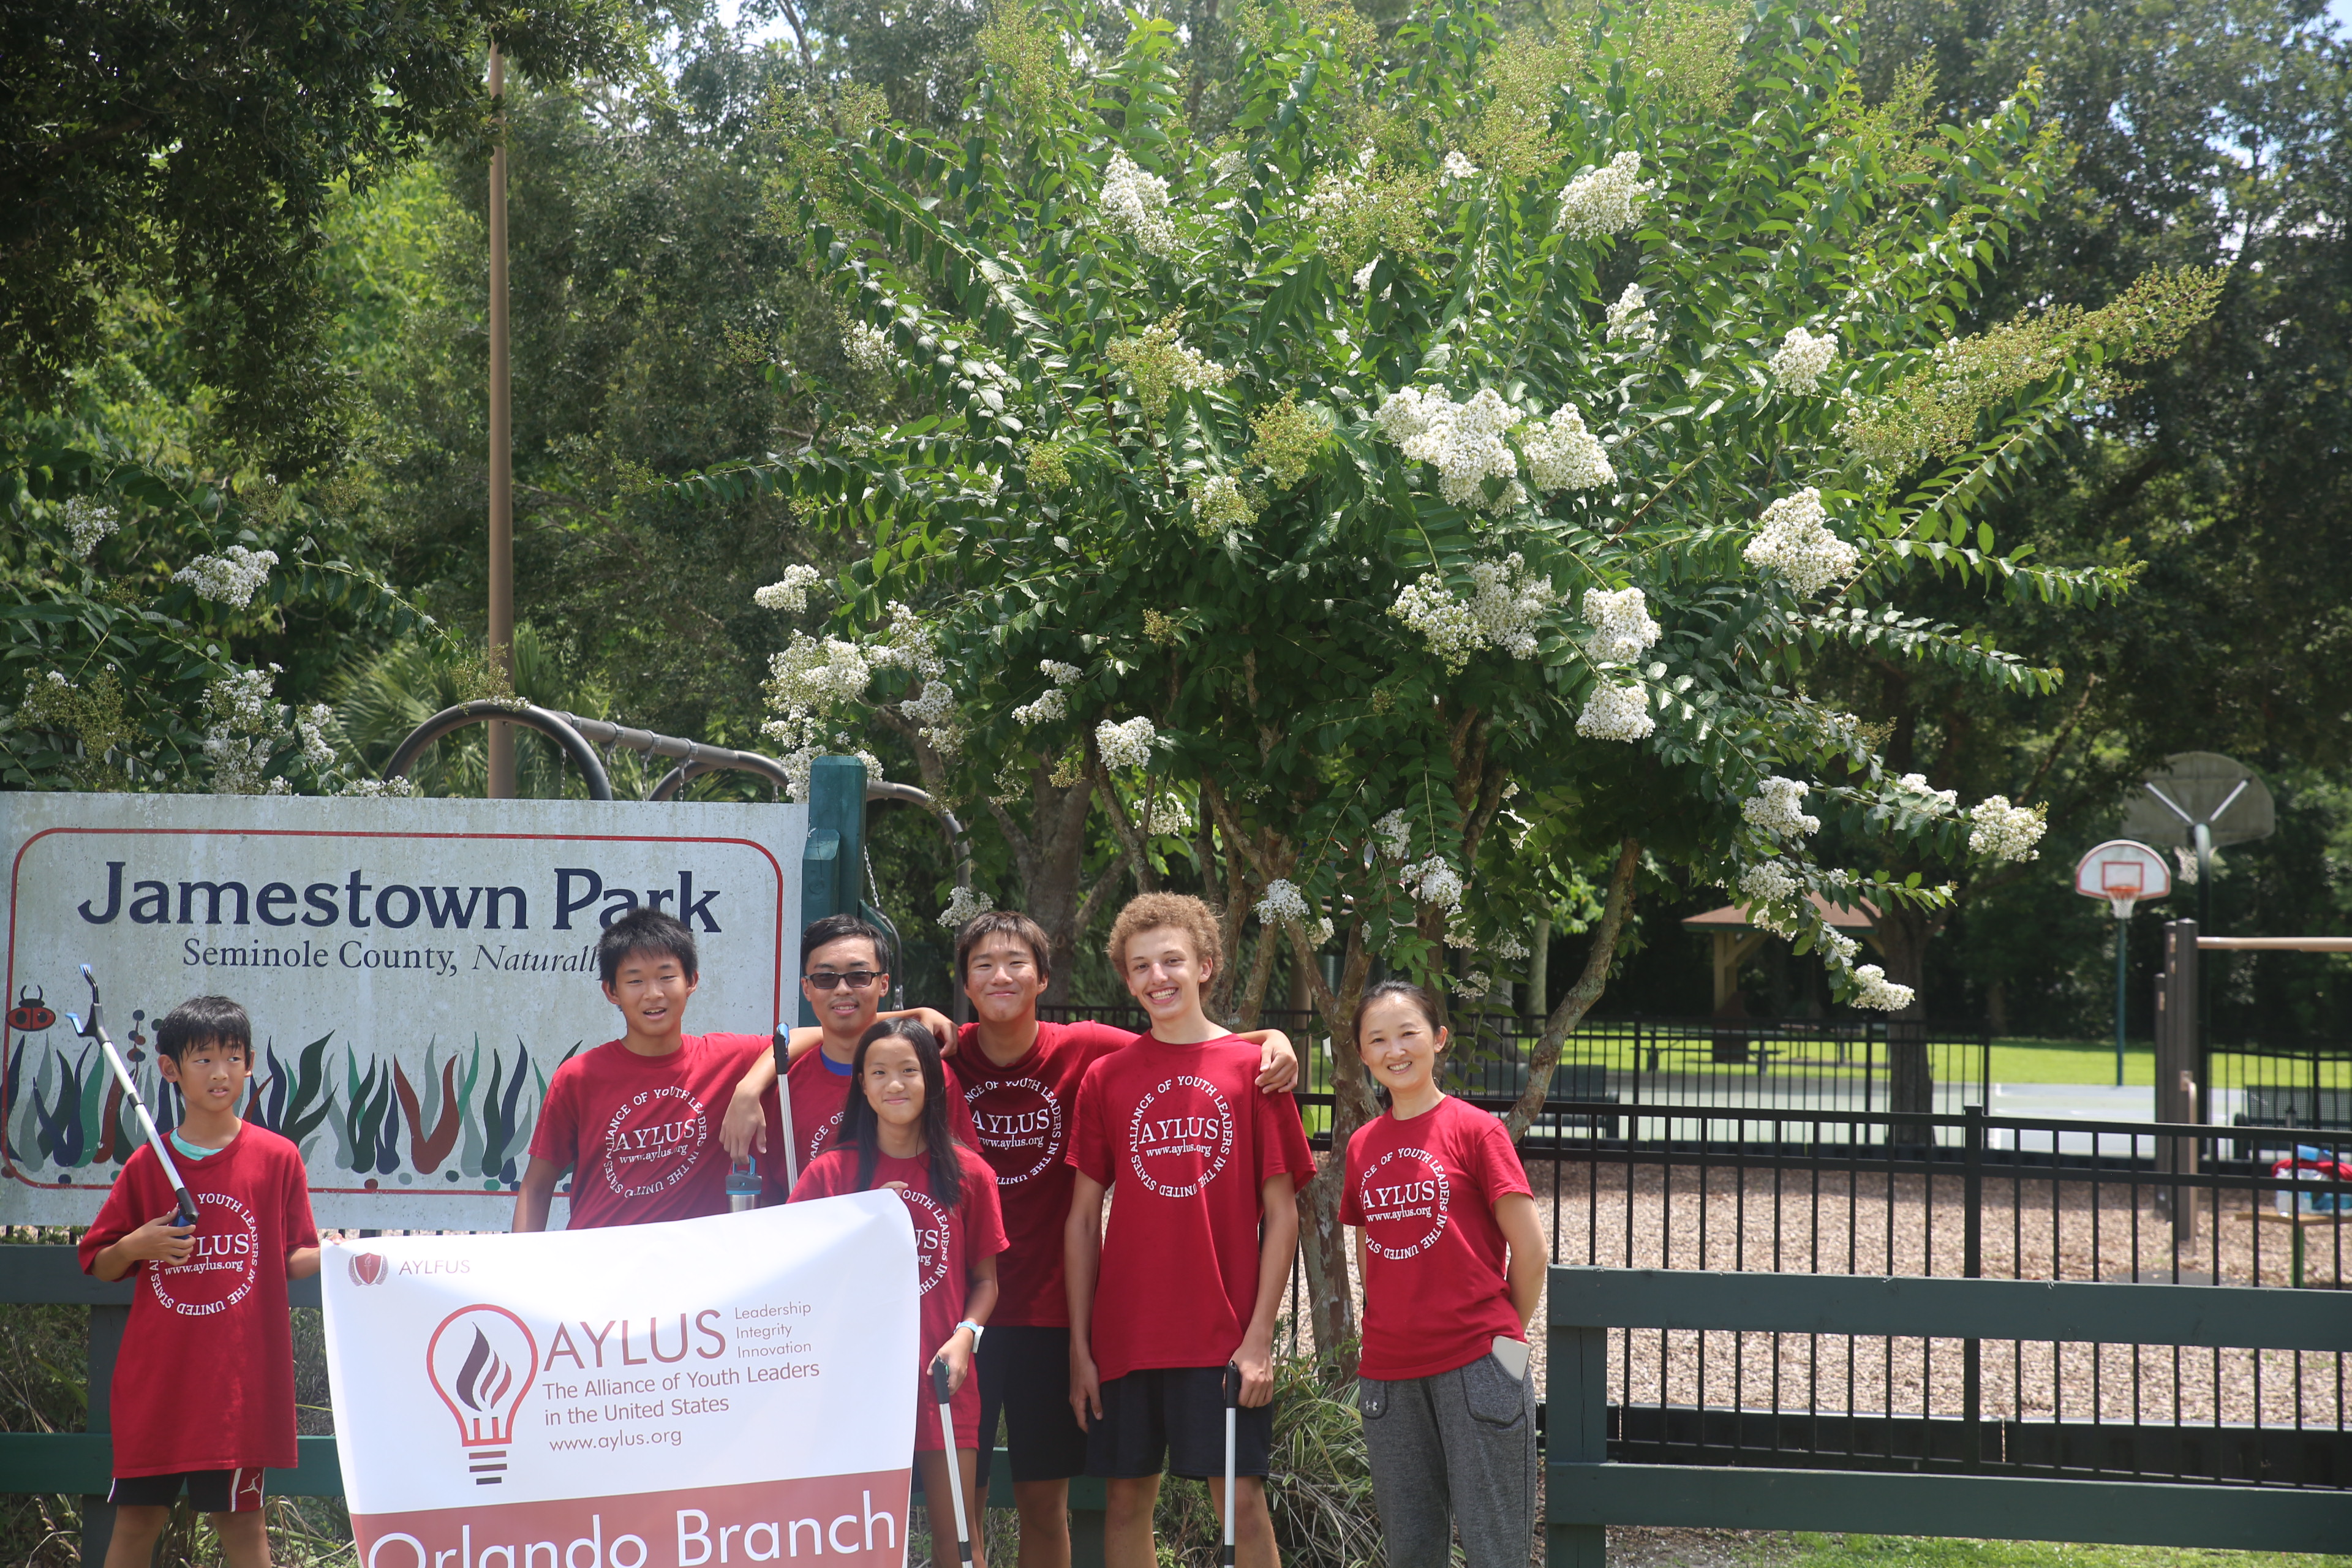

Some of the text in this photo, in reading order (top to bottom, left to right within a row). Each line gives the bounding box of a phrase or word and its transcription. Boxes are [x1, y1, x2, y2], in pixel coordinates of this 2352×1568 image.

[77, 861, 722, 933] Jamestown Park
[183, 938, 599, 977] Seminole County, Naturall
[633, 1091, 648, 1106] OF
[654, 1085, 690, 1101] YOUTH
[687, 1096, 707, 1147] LEADERS
[830, 1111, 844, 1125] OF
[971, 1108, 1050, 1135] AYLUS
[1041, 1086, 1061, 1138] LEADERS
[613, 1118, 696, 1152] AYLUS
[1129, 1076, 1233, 1198] ALLIANCE OF YOUTH LEADERS IN THE UNITED STATES
[1139, 1117, 1219, 1144] AYLUS
[619, 1145, 688, 1164] www.aylus.org
[687, 1151, 699, 1164] IN
[1047, 1142, 1059, 1155] IN
[1146, 1139, 1212, 1158] www.aylus.org
[1381, 1152, 1393, 1166] OF
[1398, 1147, 1433, 1164] YOUTH
[603, 1160, 624, 1194] STATES
[666, 1164, 690, 1185] THE
[1030, 1157, 1051, 1176] THE
[996, 1174, 1028, 1185] UNIT
[1429, 1159, 1450, 1212] LEADERS
[197, 1193, 243, 1213] YOUTH
[902, 1189, 936, 1210] OUTH
[1363, 1180, 1435, 1210] AYLUS
[1366, 1204, 1432, 1223] www.aylus.org
[1436, 1213, 1448, 1229] IN
[195, 1233, 250, 1257] LUS
[240, 1209, 258, 1267] LEADERS
[932, 1207, 950, 1262] LEADERS
[1365, 1232, 1382, 1254] STA
[1420, 1227, 1442, 1250] THE
[1384, 1245, 1420, 1260] UNITED
[165, 1257, 244, 1276] www.aylus.org
[247, 1268, 256, 1284] IN
[399, 1259, 470, 1276] AYLFUS
[934, 1262, 948, 1278] IN
[151, 1273, 175, 1309] STATES
[227, 1283, 251, 1305] THE
[176, 1300, 226, 1316] UNITED
[734, 1301, 812, 1320] Leadership
[543, 1308, 726, 1372] AYLUS
[736, 1322, 793, 1340] Integrity
[737, 1340, 812, 1359] Innovation
[543, 1362, 820, 1401] The Alliance of Youth Leaders
[545, 1396, 729, 1426] in the United States
[549, 1428, 682, 1452] www.aylus.org
[368, 1490, 895, 1568] Orlando Branch
